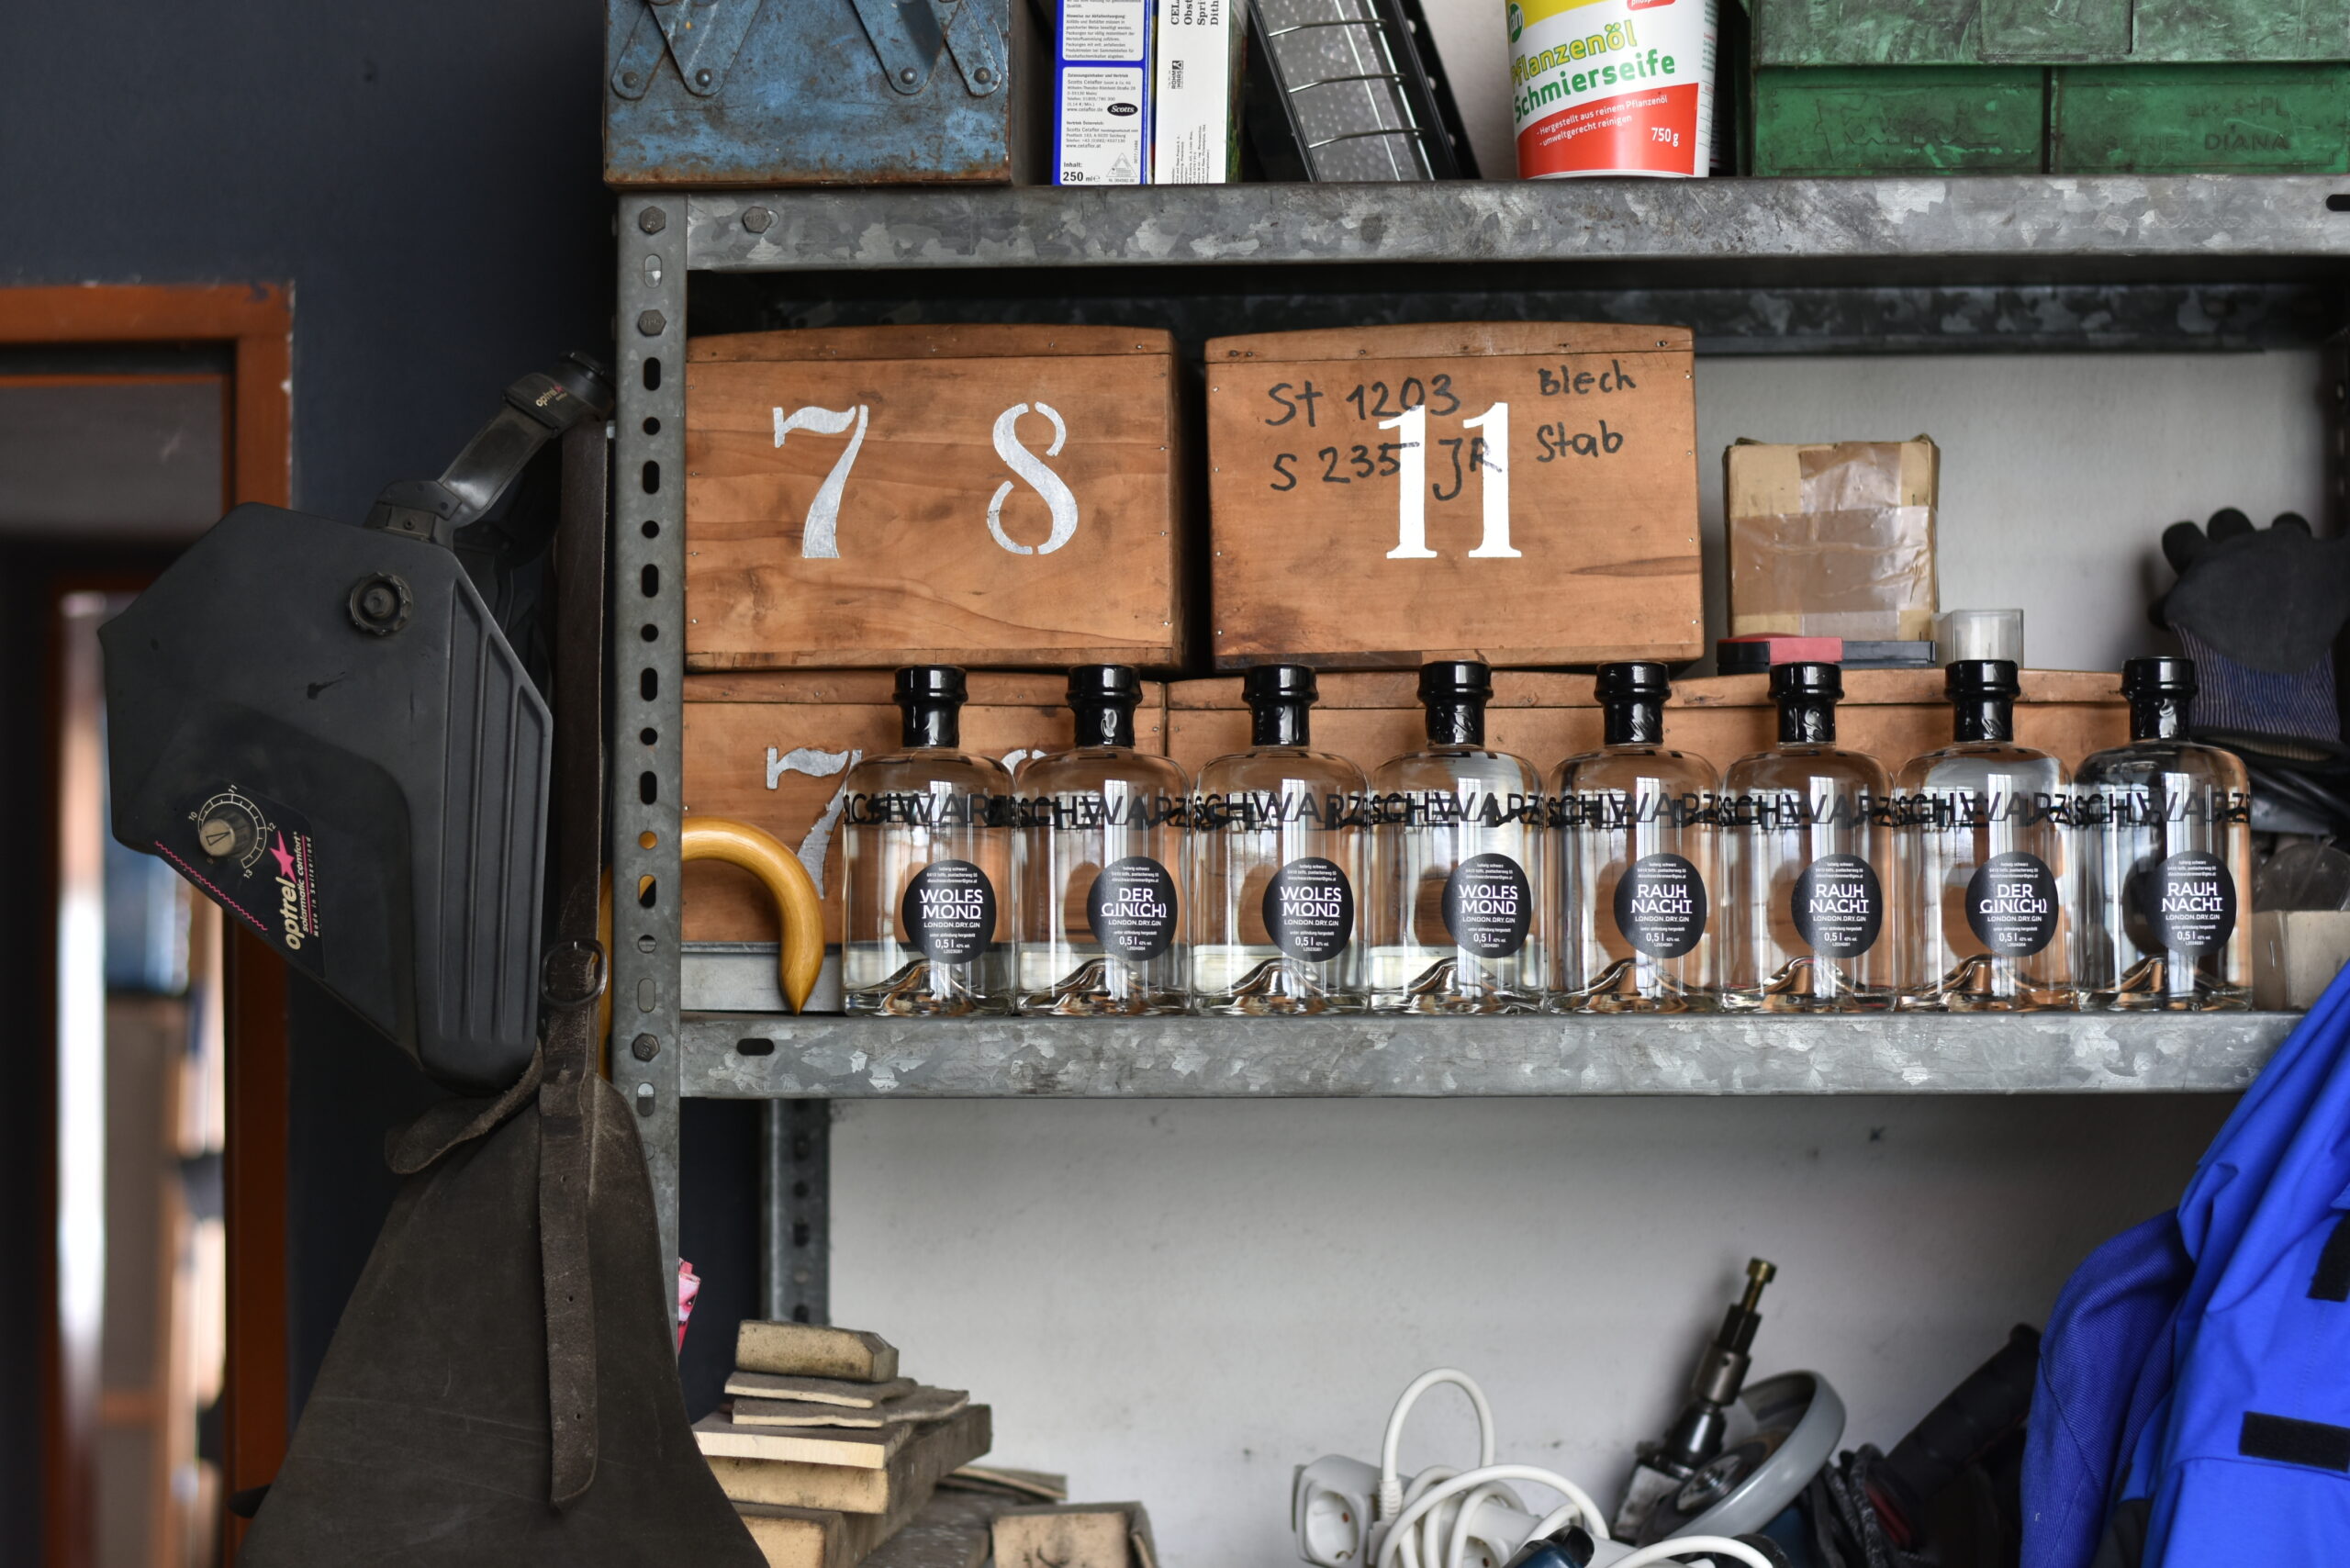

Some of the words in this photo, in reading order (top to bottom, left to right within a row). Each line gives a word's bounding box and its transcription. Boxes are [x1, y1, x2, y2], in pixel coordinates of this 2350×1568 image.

[1171, 0, 1180, 25] CEL
[1197, 0, 1208, 26] Spri
[1510, 19, 1637, 95] Pflanzenöl
[1514, 49, 1674, 124] Schmierseife
[1539, 115, 1579, 136] Hergestellt
[1580, 111, 1595, 121] aus
[1595, 104, 1626, 118] reinem
[1626, 95, 1668, 110] Pflanzenöl
[1542, 123, 1597, 147] umweltgerecht
[1597, 115, 1632, 128] reinigen
[1651, 127, 1672, 142] 750
[1673, 133, 1679, 147] g
[2204, 133, 2290, 151] DIANA
[1062, 172, 1083, 182] 250
[1266, 380, 1323, 427] St
[1346, 374, 1460, 420] 1203
[1270, 454, 1297, 491] S
[1318, 443, 1420, 484] 235
[1537, 420, 1624, 462] Stab
[773, 404, 868, 558] 7
[987, 402, 1079, 554] 8
[1378, 402, 1522, 558] 11
[229, 784, 237, 794] 11
[188, 811, 198, 822] 10
[267, 822, 276, 833] 12
[294, 835, 305, 876] comfort
[243, 868, 253, 879] 13
[920, 889, 983, 903] WOLFS
[1119, 888, 1154, 902] DER
[1280, 887, 1342, 902] WOLFS
[1459, 885, 1518, 900] WOLFS
[1637, 884, 1687, 898] RAUH
[1815, 884, 1864, 898] RAUH
[1997, 884, 2033, 898] DER
[2166, 881, 2218, 896] RAUH
[297, 879, 308, 933] solarmatic
[922, 904, 981, 919] MOND
[1101, 902, 1167, 918] GIN(CH)
[1281, 902, 1339, 917] MOND
[1460, 900, 1516, 914] MOND
[1630, 900, 1693, 913] NACHT
[1809, 899, 1869, 913] NACHT
[1979, 898, 2047, 913] GIN(CH)
[2161, 897, 2223, 912] NACHT
[275, 876, 306, 950] optrel
[935, 939, 949, 948] 0,5
[1120, 936, 1132, 946] 0,5
[1295, 936, 1308, 946] 0,5
[1473, 933, 1486, 944] 0,5
[1646, 933, 1660, 943] 0,5
[1824, 933, 1837, 942] 0,5
[1999, 933, 2012, 942] 0,5
[2177, 931, 2190, 941] 0,5
